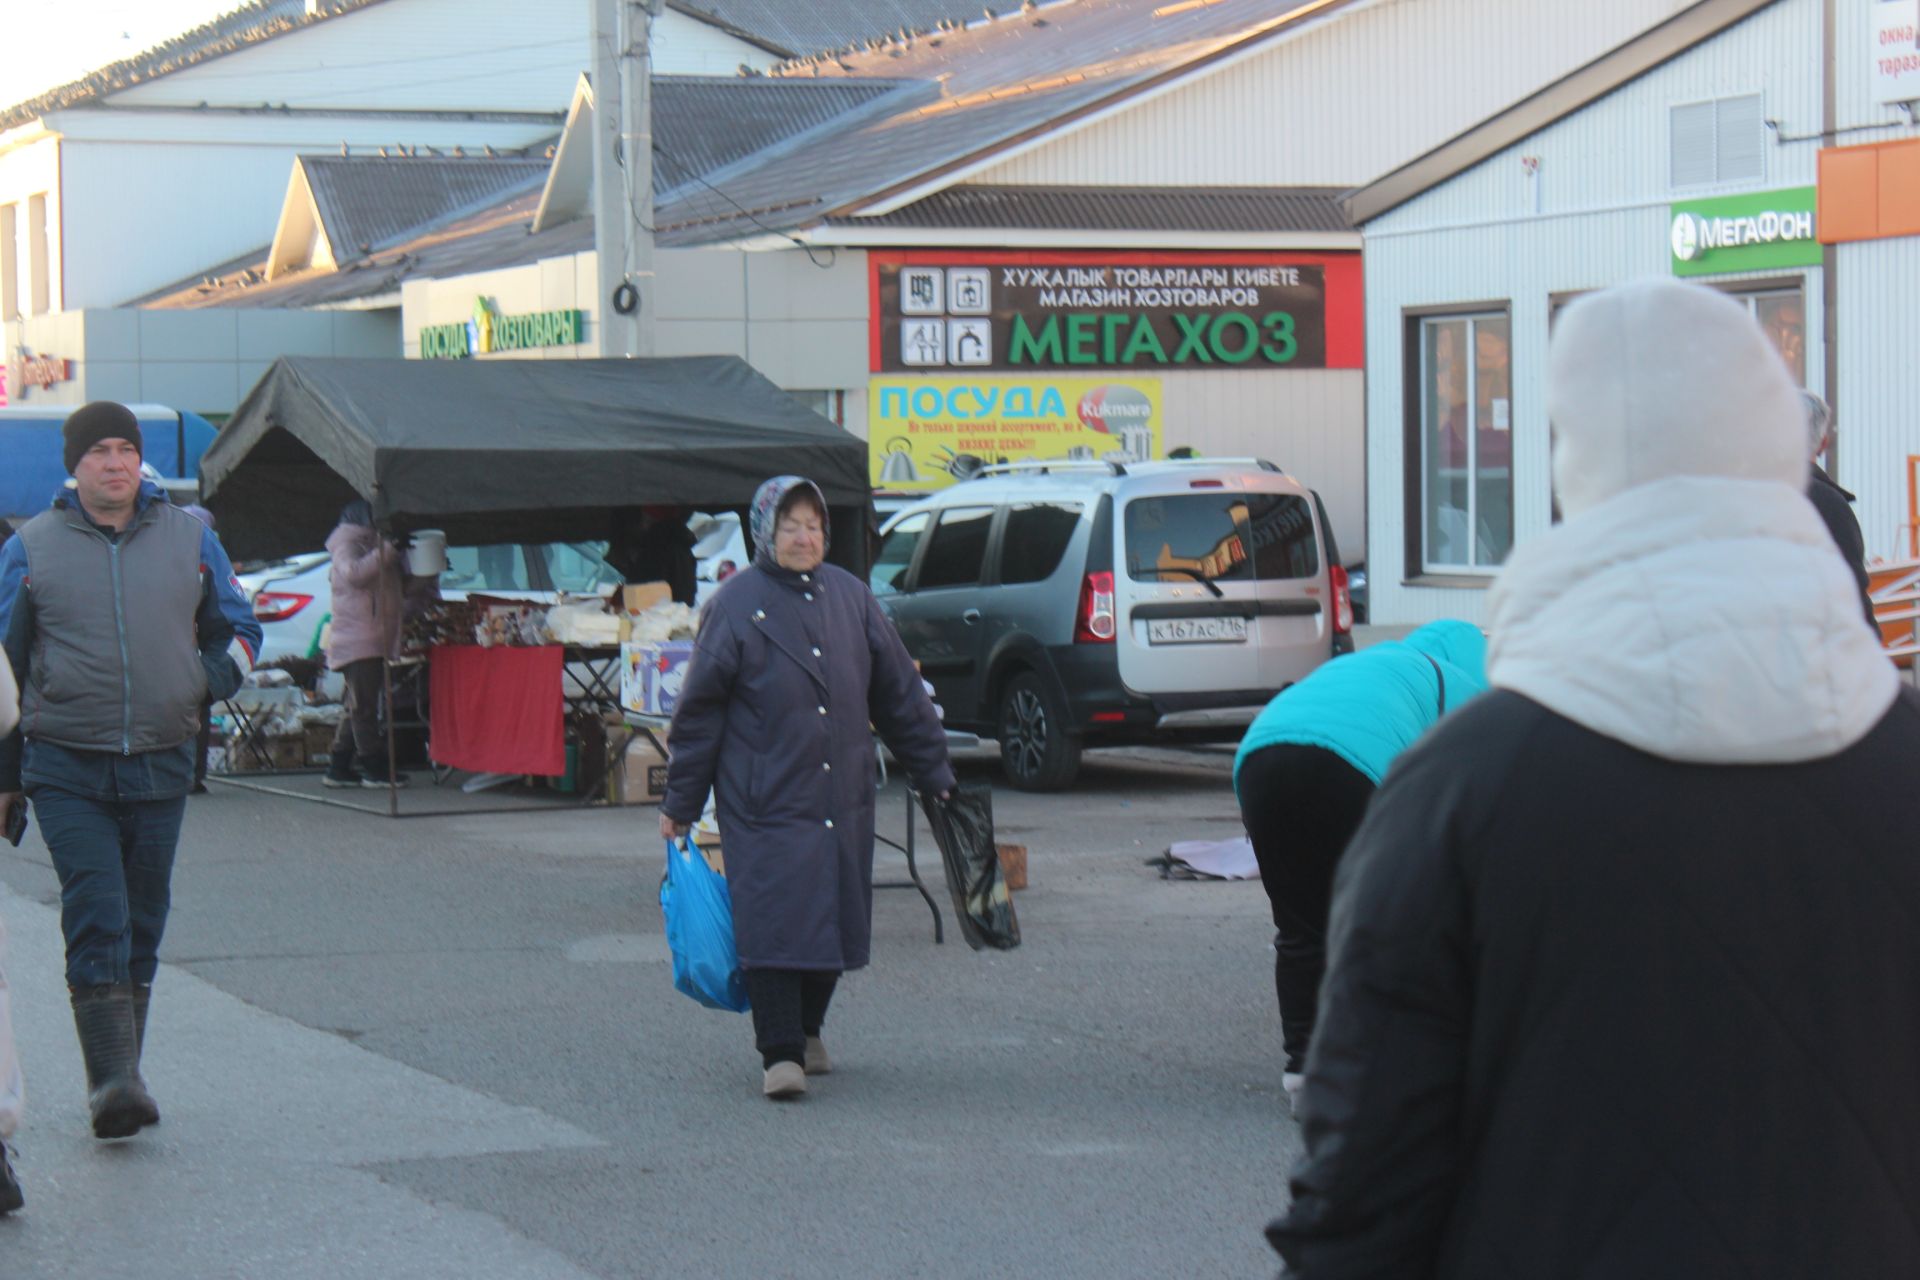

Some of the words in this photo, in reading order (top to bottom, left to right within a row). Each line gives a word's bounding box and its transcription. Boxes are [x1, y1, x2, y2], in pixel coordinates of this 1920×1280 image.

[1879, 25, 1913, 45] окна
[1114, 268, 1228, 287] ТОВАРЛАРЫ
[1233, 267, 1300, 286] КИБЕТЕ
[1039, 288, 1131, 307] МАГАЗИН
[1134, 288, 1260, 307] ХОЗТОВАРОВ
[490, 309, 578, 350] ХОЗТОВАРЫ
[880, 386, 1066, 419] ПОСУДА
[1081, 400, 1151, 418] Kukmara
